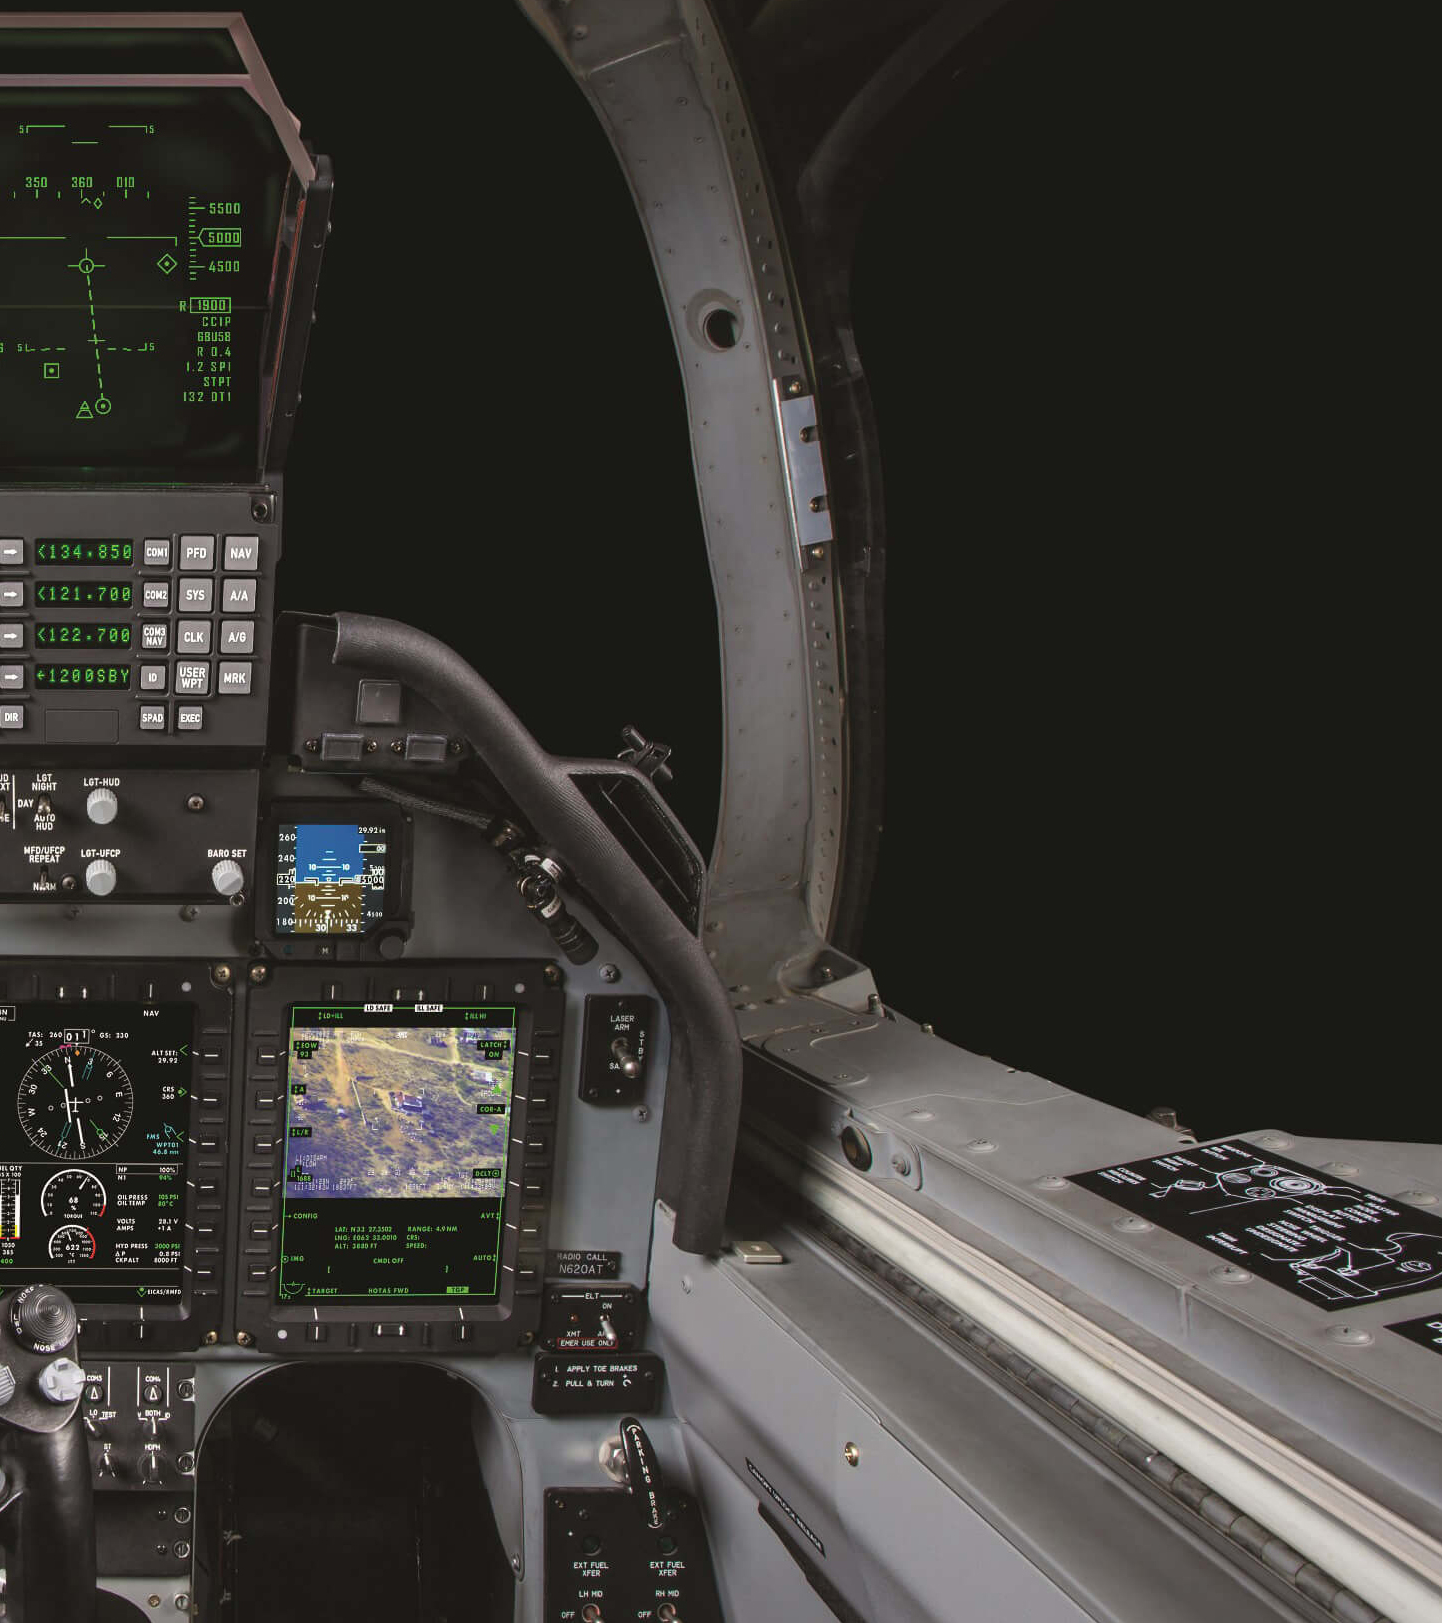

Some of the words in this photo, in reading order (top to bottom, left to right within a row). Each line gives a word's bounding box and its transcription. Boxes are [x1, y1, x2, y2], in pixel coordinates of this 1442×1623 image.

[25, 177, 48, 188] 350
[71, 177, 93, 188] 360
[209, 203, 241, 214] 5500
[208, 232, 240, 243] 5000
[209, 261, 240, 272] 4500
[180, 301, 186, 312] R
[197, 299, 226, 311] 1900
[202, 317, 231, 327] CCIP
[203, 377, 231, 387] STPT
[147, 548, 168, 557] COM1
[186, 547, 207, 559] PFD
[230, 548, 252, 559] NAV
[145, 591, 167, 600] COM2
[186, 590, 205, 600] SYS
[230, 591, 248, 601] A/A
[144, 627, 165, 636] COM3
[146, 637, 163, 646] NAV
[184, 632, 203, 643] CLK
[228, 632, 246, 643] A/G
[180, 667, 205, 678] USER
[148, 673, 157, 682] ID
[224, 673, 245, 683] MRK
[182, 678, 203, 689] WPT
[5, 713, 18, 722] DIR
[142, 713, 163, 722] SPAD
[180, 713, 200, 722] EXEC
[36, 773, 53, 782] LGT
[32, 782, 57, 791] NIGHT
[83, 778, 120, 787] LGT-HUD
[17, 799, 34, 808] DAY
[36, 822, 53, 831] HUD
[24, 846, 65, 855] MFD/UFCP
[81, 849, 120, 858] LGT-UFCP
[207, 849, 229, 858] BARO
[231, 849, 247, 858] SET
[29, 855, 60, 863] REPEAT
[347, 924, 357, 932] 33
[559, 1265, 603, 1274] N620AT
[33, 1343, 55, 1351] NOSE
[631, 1427, 651, 1483] PARKING
